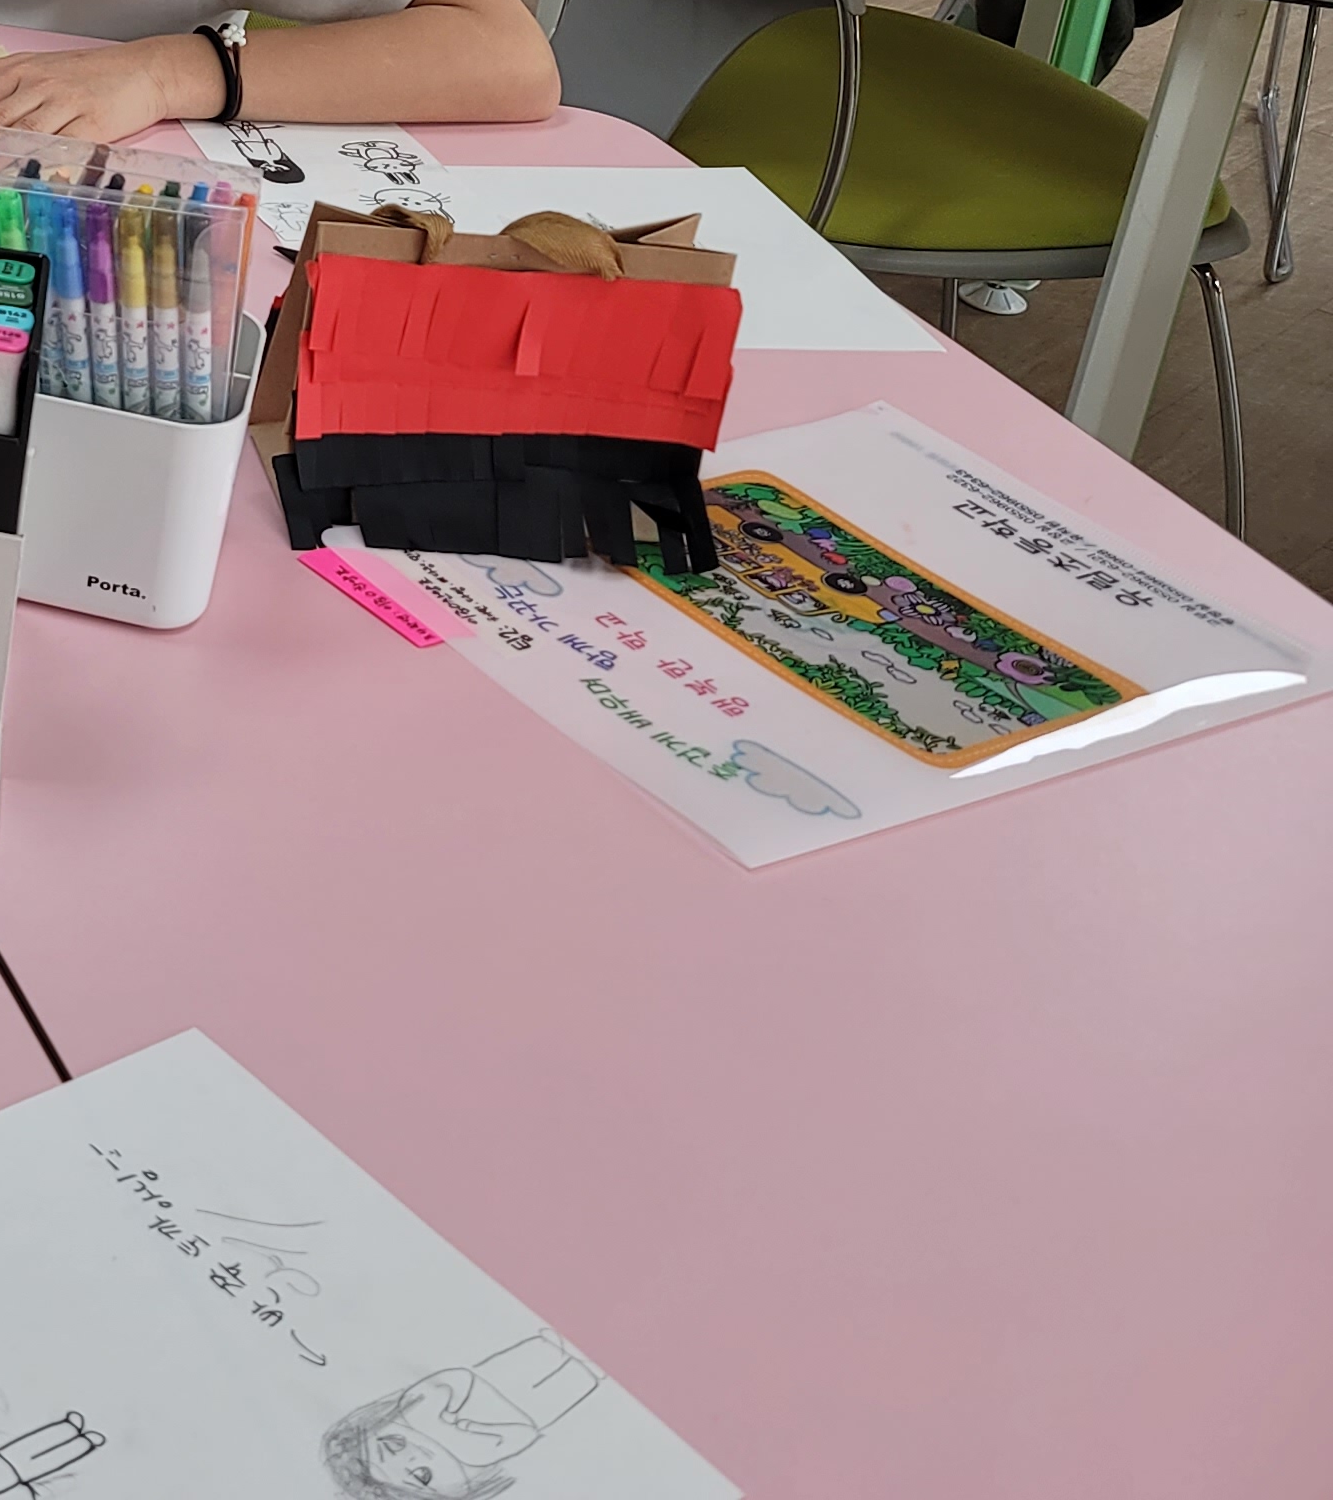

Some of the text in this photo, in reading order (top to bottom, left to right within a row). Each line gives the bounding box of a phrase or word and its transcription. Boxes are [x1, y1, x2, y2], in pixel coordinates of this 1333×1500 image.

[87, 575, 147, 601] Porta.
[952, 499, 1154, 608] 유림초등학교
[495, 583, 619, 671] 함께 가꾸는
[594, 611, 750, 718] 행복한 학교
[579, 677, 739, 781] 즐겁게 배우며
